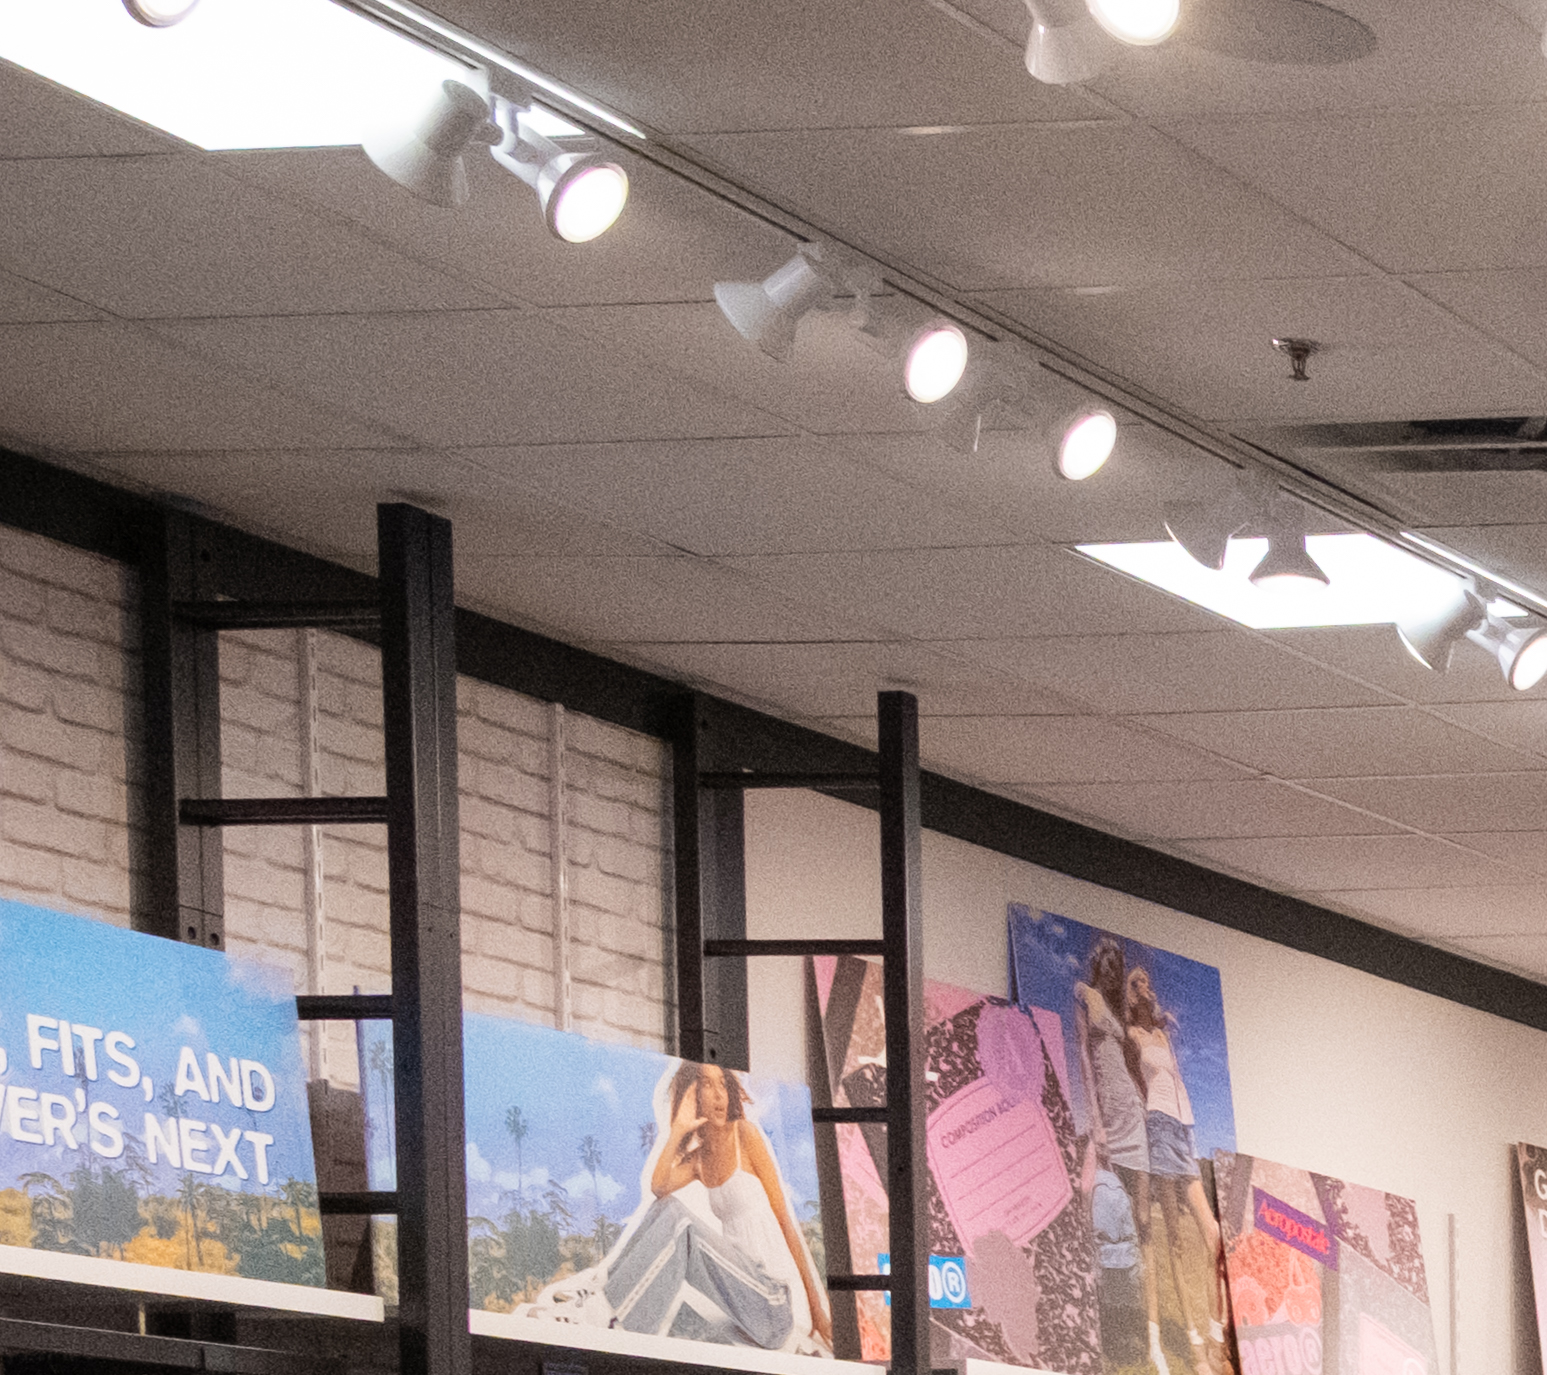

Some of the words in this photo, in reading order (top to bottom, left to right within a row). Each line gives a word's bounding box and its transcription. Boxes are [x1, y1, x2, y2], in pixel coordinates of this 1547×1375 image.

[26, 1013, 154, 1102] FITS,
[174, 1046, 276, 1113] AND
[144, 1112, 275, 1185] NEXT
[940, 1105, 998, 1149] COMPOSITION
